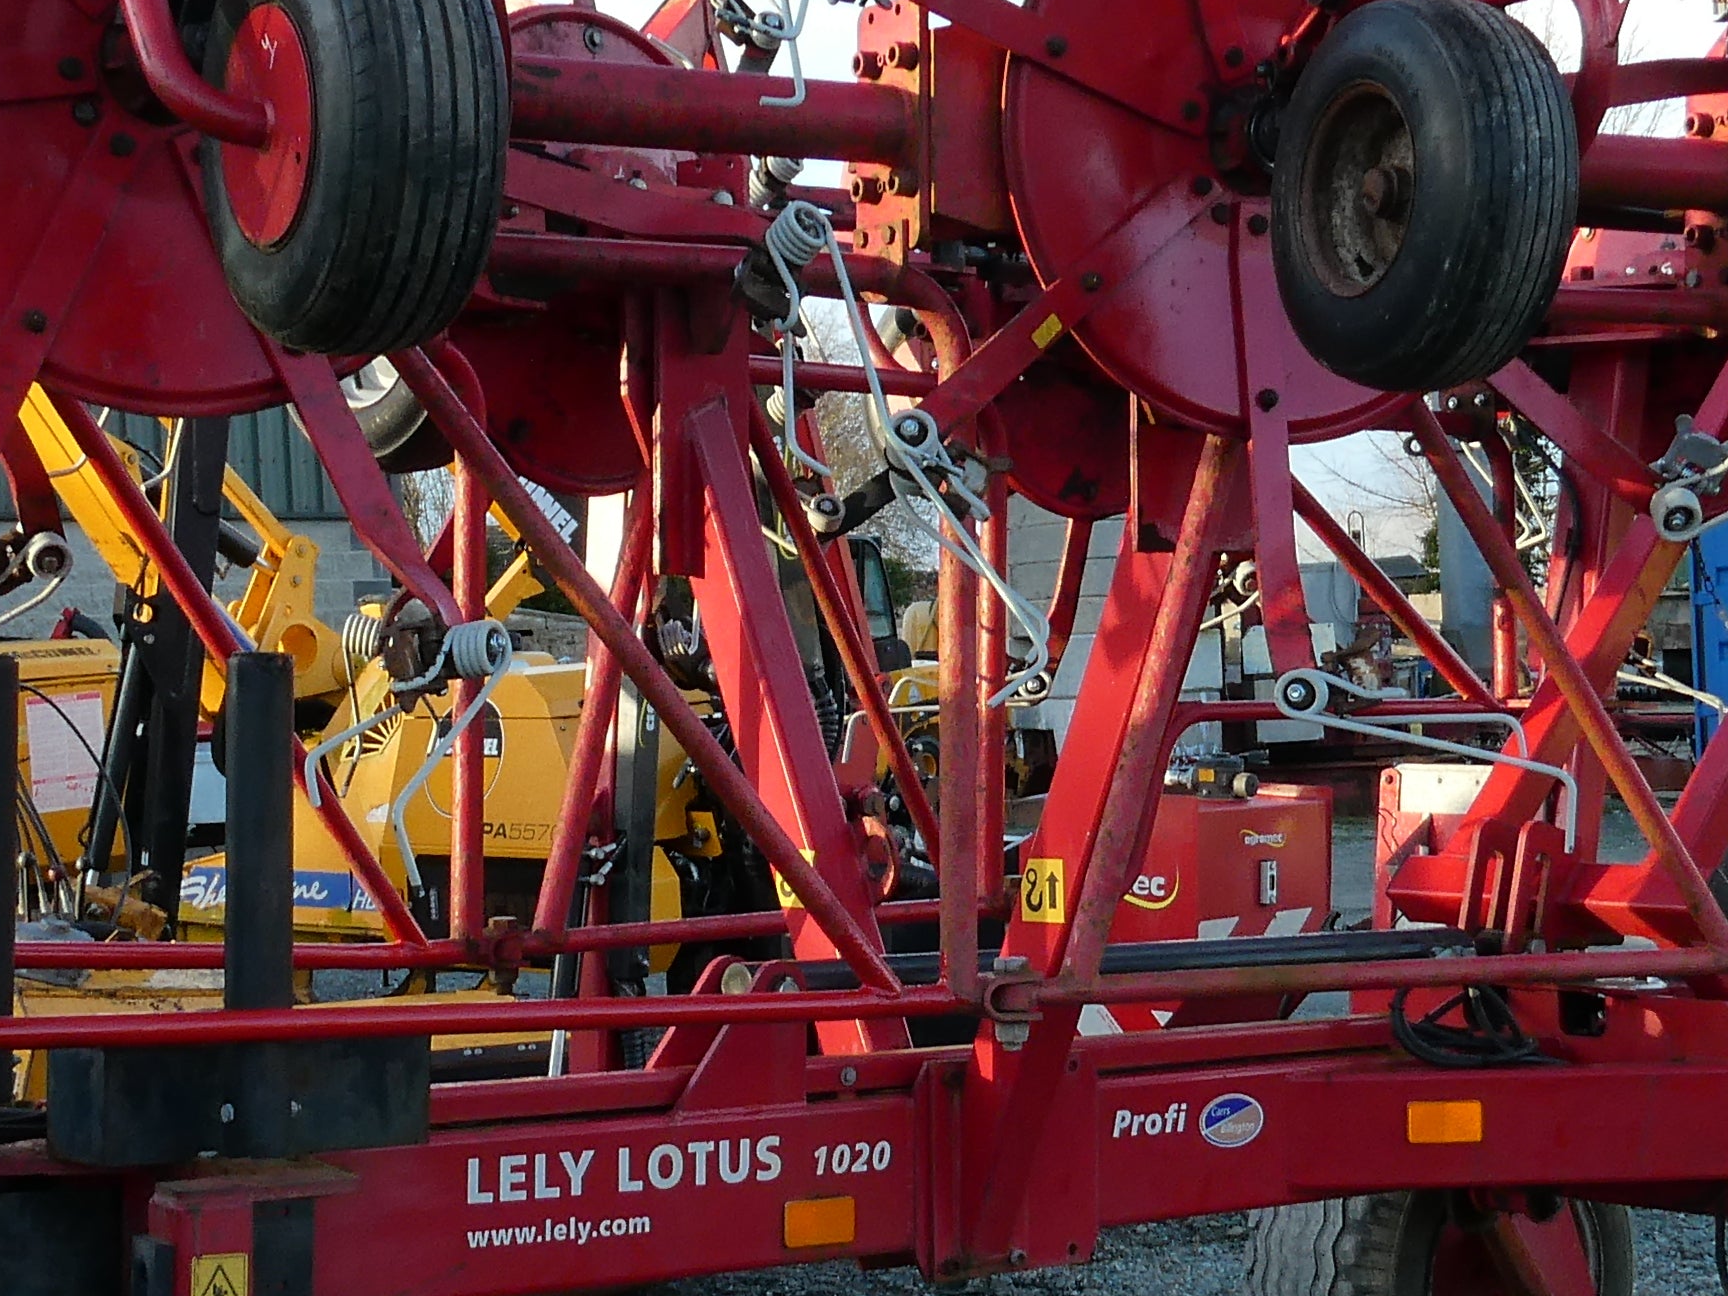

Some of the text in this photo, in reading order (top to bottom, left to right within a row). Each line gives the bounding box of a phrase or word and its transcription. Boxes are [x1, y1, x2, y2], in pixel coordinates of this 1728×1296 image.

[1112, 1103, 1188, 1139] Profi
[467, 1135, 891, 1204] LELY LOTUS 1020
[467, 1214, 651, 1249] www.lely.com
